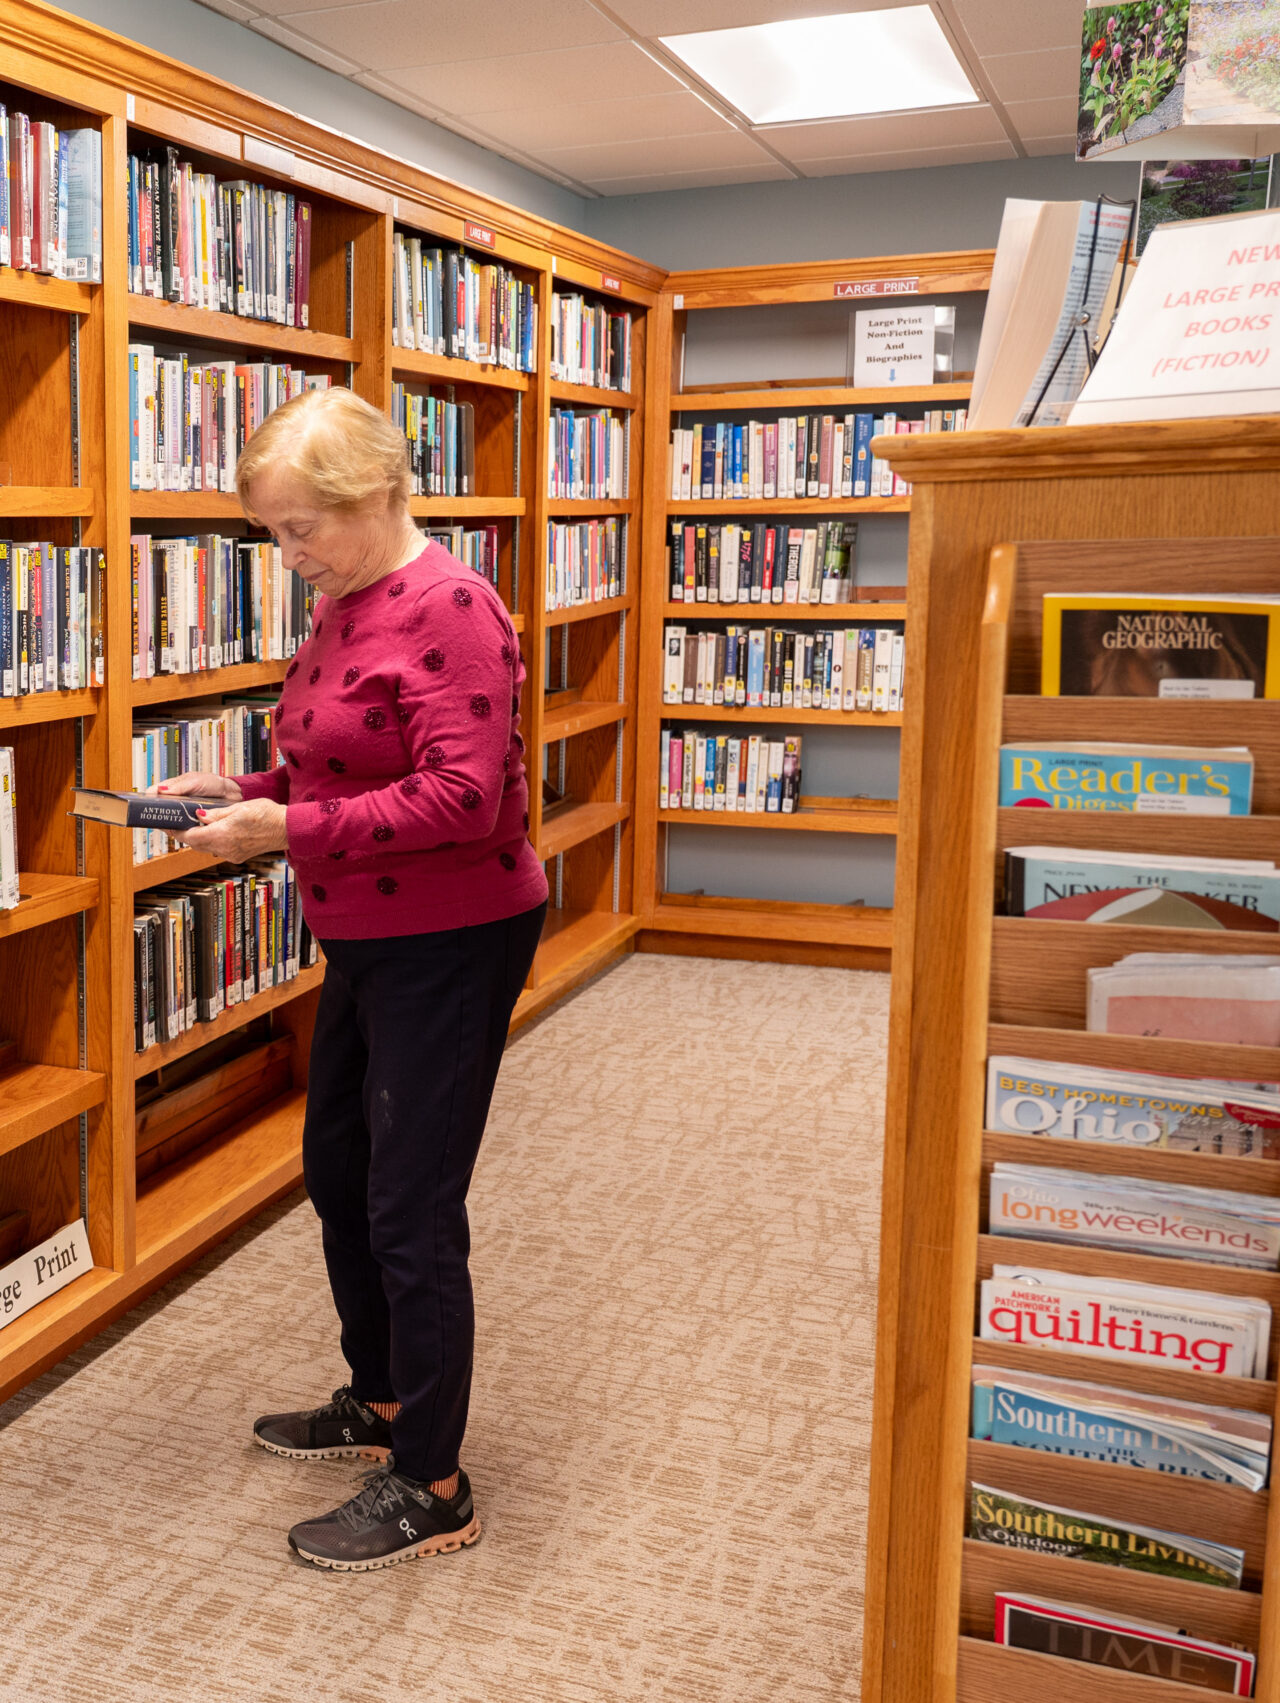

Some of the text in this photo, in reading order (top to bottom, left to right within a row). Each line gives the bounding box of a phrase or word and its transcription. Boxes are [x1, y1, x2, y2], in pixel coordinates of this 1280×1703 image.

[837, 281, 916, 296] LARGE PRINT
[1163, 285, 1244, 308] LARGE
[867, 329, 923, 339] Non-Fiction
[1184, 314, 1272, 337] BOOKS
[866, 354, 922, 363] Biographies
[1152, 348, 1270, 377] (FICTION)
[787, 545, 800, 581] THEROUX
[1117, 615, 1212, 632] NATIONAL
[1102, 631, 1222, 650] GEOGRAPHIC
[1049, 759, 1076, 767] LARGE
[1009, 757, 1230, 797] Reader's
[140, 813, 184, 823] HOROWITZ
[143, 806, 182, 816] ANTHONY
[1134, 875, 1170, 886] THE
[999, 1076, 1059, 1099] BEST
[1064, 1088, 1225, 1119] HOMETOWNS
[999, 1095, 1161, 1144] Ohio
[34, 1241, 78, 1285] Print
[995, 1296, 1061, 1315] PATCHWORK &
[1011, 1290, 1061, 1304] AMERICAN
[1108, 1304, 1139, 1316] Better
[1141, 1309, 1179, 1322] Homes
[988, 1301, 1233, 1374] quilting
[996, 1392, 1142, 1448] Southern
[975, 1494, 1228, 1579] Southern Living
[991, 1529, 1077, 1553] Outdoor
[1031, 1617, 1212, 1685] TIME
